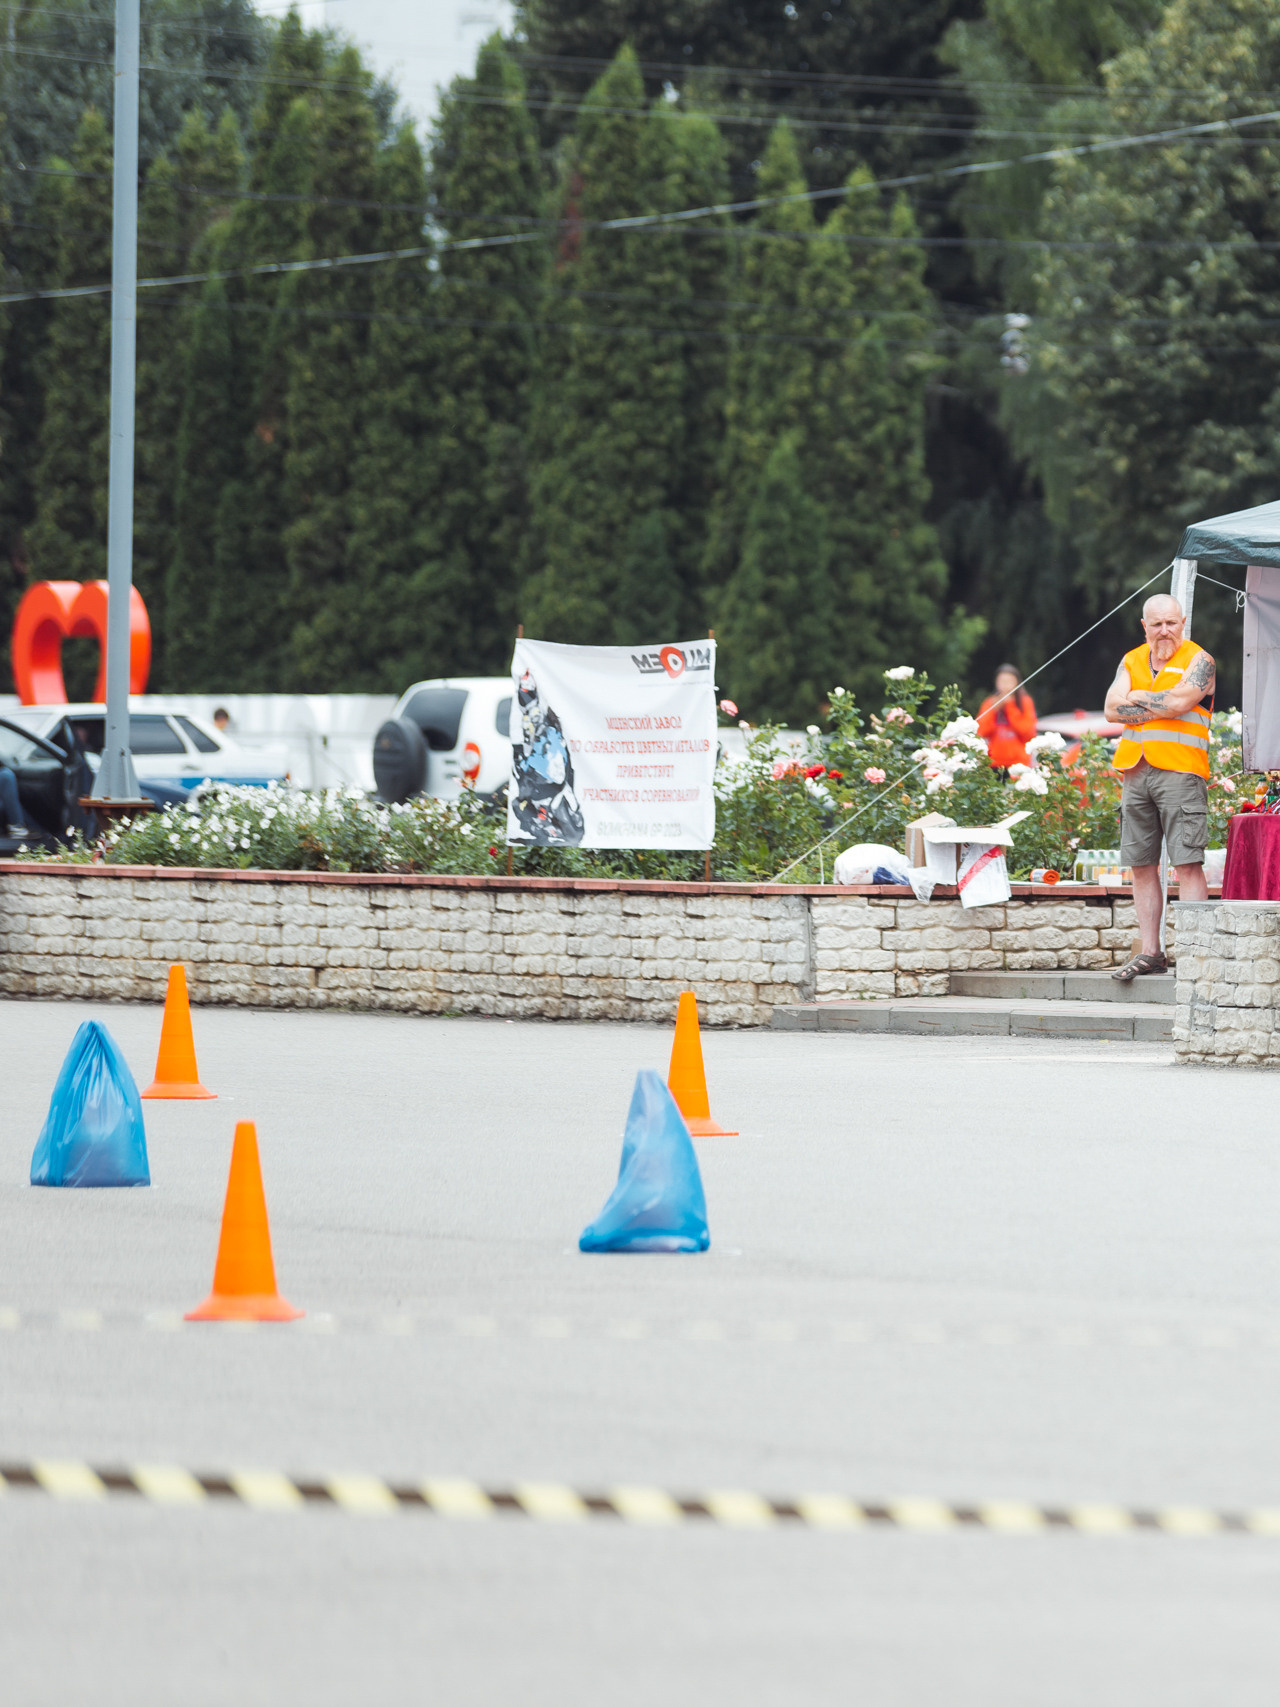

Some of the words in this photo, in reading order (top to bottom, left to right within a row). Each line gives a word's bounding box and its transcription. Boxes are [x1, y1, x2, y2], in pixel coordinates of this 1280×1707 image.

[655, 716, 682, 730] ЗАВОД
[584, 740, 636, 754] ОБРАБОТКЕ
[637, 740, 674, 754] ЦВЕТНЫХ
[616, 765, 675, 778] ПРИВЕТСТВУЕТ
[583, 788, 640, 802] УЧАСТНИКОВ
